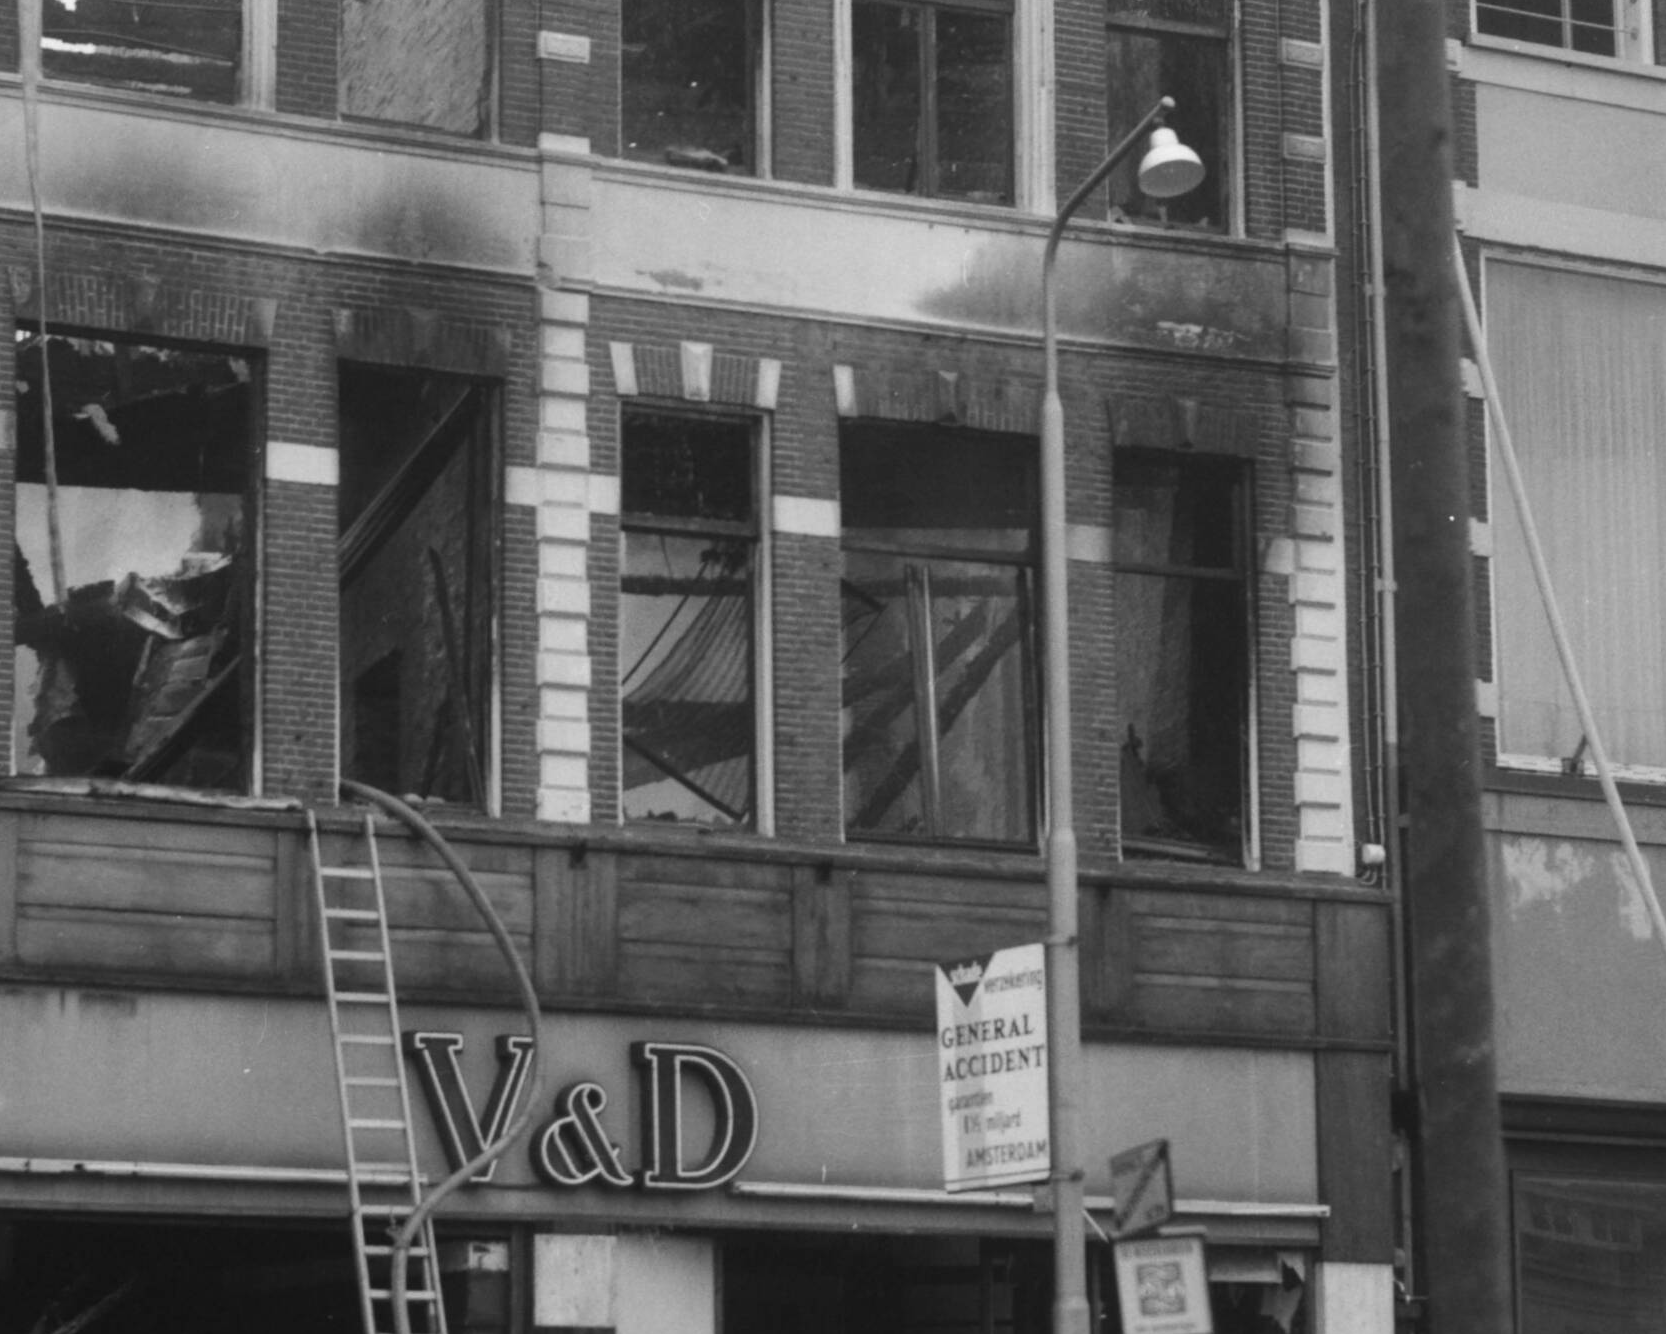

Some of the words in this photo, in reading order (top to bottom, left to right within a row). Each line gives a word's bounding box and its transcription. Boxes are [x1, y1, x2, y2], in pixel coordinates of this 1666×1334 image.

[941, 1013, 1035, 1049] GENERAL
[943, 1043, 1046, 1083] ACCIDENT
[965, 1138, 1049, 1168] AMSTERDAM
